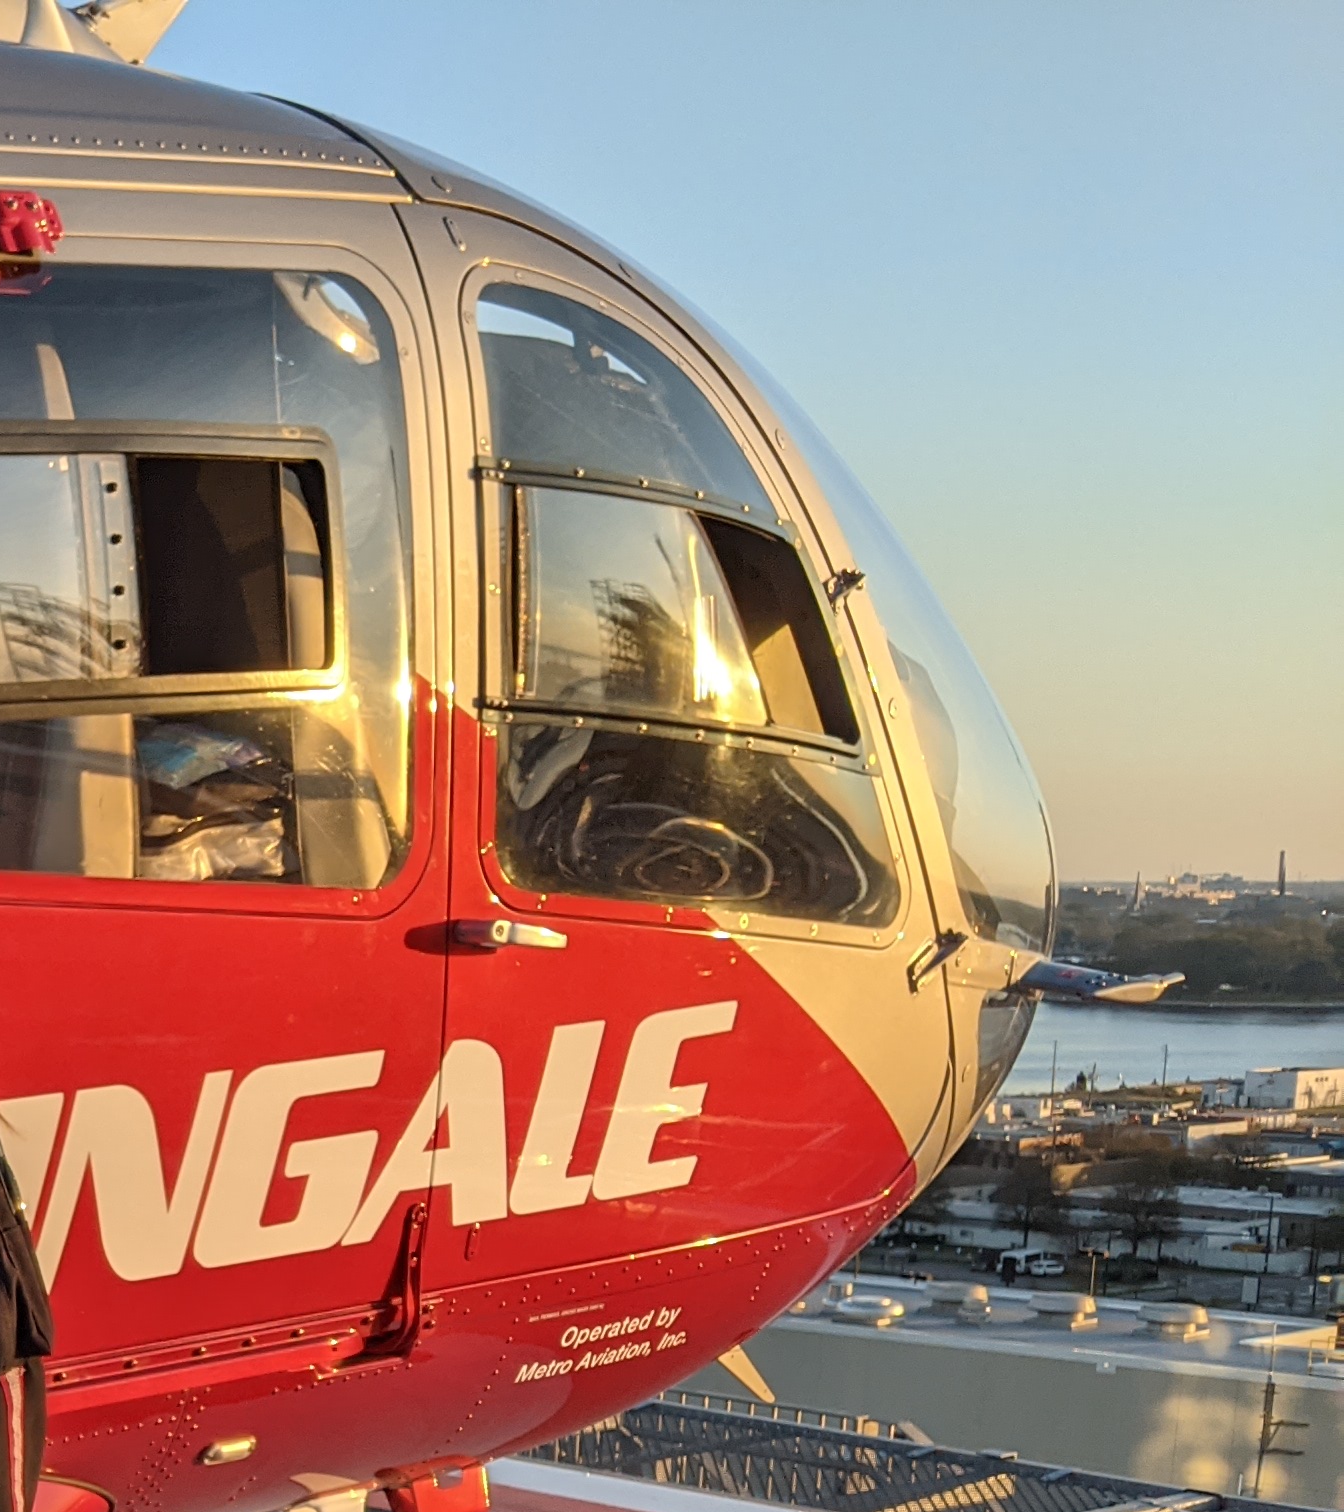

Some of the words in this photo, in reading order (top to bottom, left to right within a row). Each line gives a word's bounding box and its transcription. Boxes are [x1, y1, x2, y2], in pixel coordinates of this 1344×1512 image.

[561, 1309, 655, 1350] Operated
[655, 1306, 682, 1329] by
[514, 1358, 574, 1384] Metro
[574, 1340, 652, 1372] Aviation,
[656, 1330, 687, 1352] Inc.
